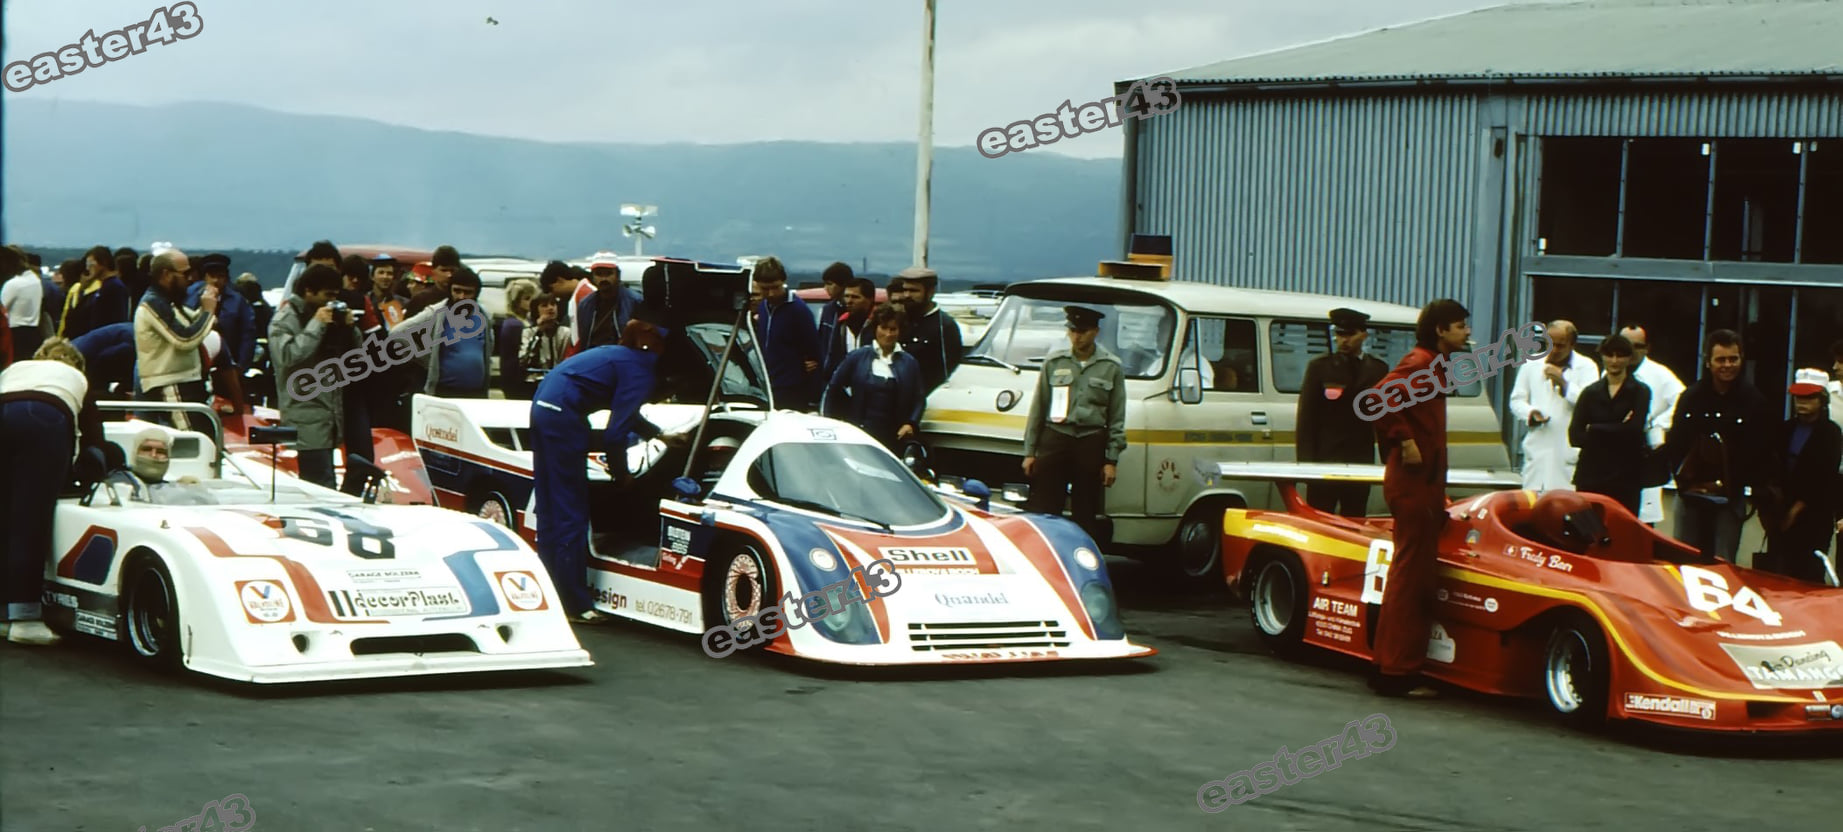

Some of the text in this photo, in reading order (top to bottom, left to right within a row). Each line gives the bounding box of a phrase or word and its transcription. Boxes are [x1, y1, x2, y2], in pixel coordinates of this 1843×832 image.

[887, 549, 969, 561] Shell
[1680, 565, 1783, 626] 64
[1313, 596, 1358, 617] AIR TEAM
[1633, 694, 1690, 713] Kendall
